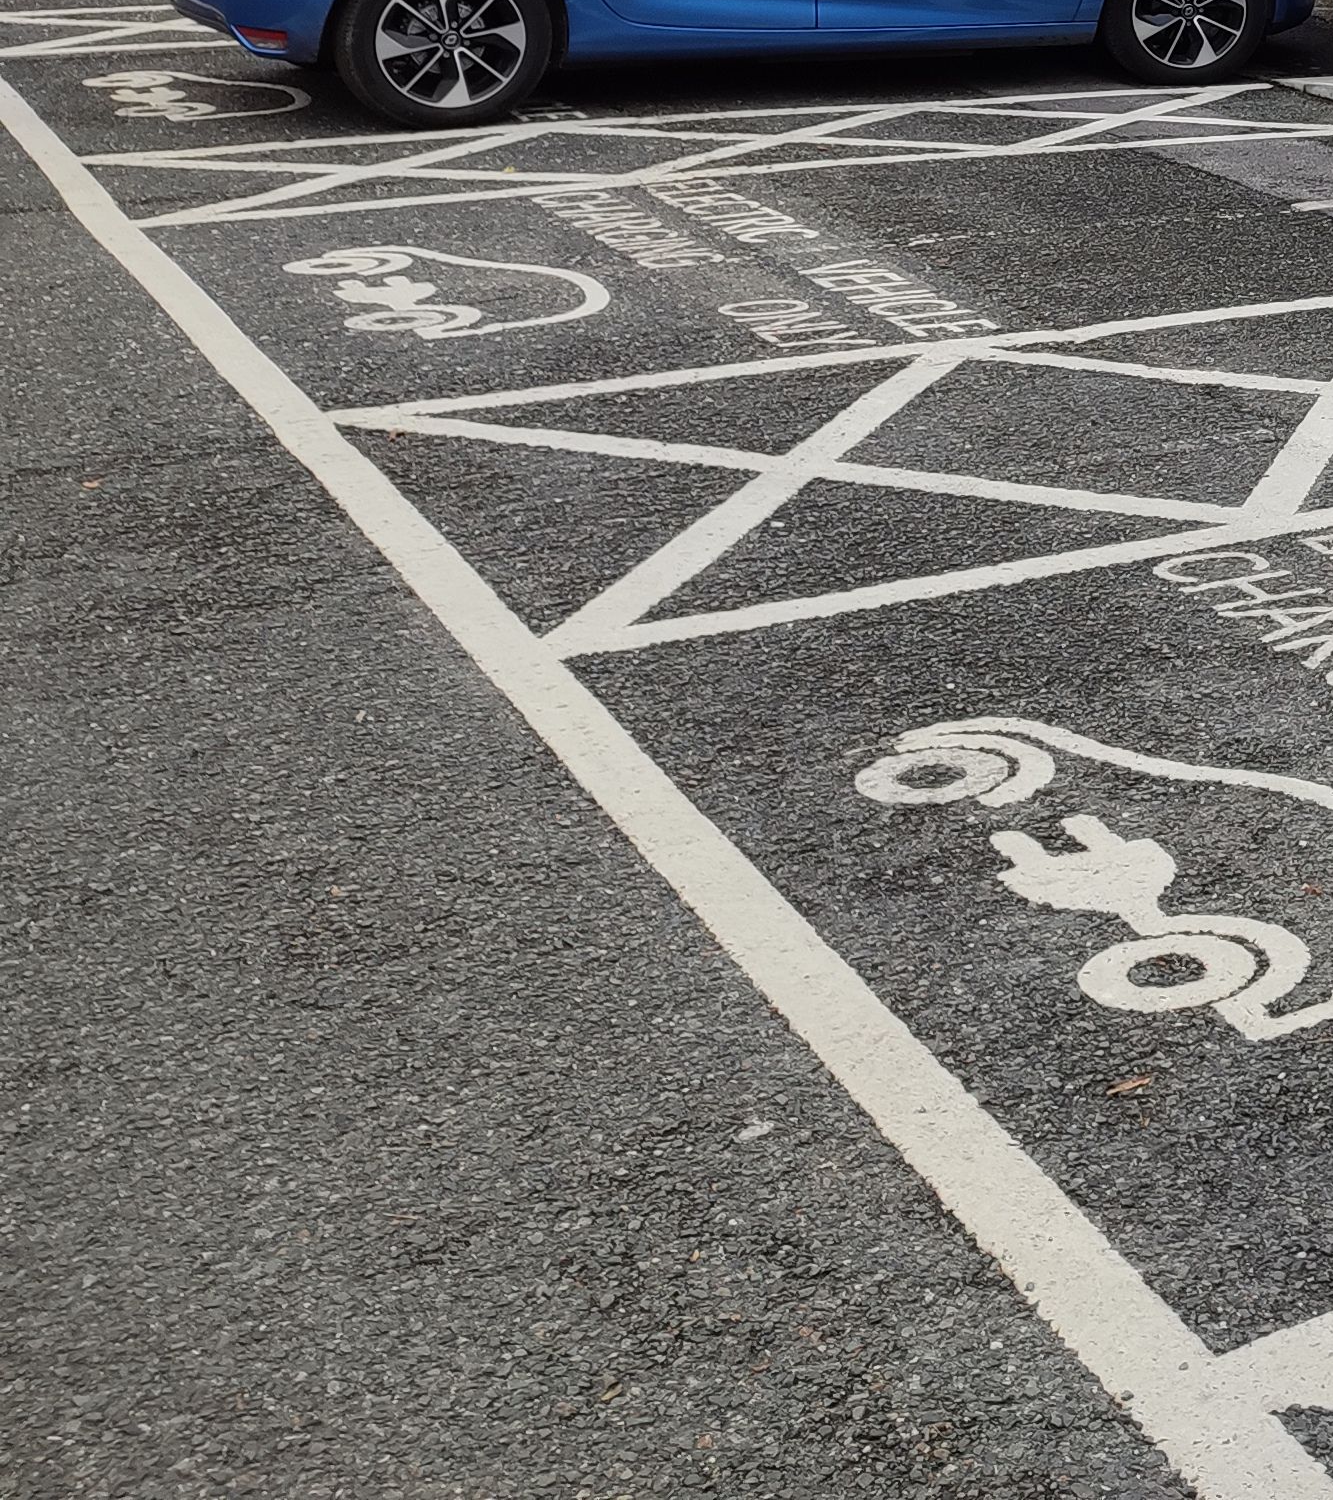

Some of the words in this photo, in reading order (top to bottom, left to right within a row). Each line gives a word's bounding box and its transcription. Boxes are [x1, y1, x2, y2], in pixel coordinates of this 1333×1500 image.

[532, 192, 725, 268] CHARGING
[718, 300, 876, 347] ONLY
[646, 179, 819, 243] ELECTRIC
[799, 259, 1000, 337] VEHICLE
